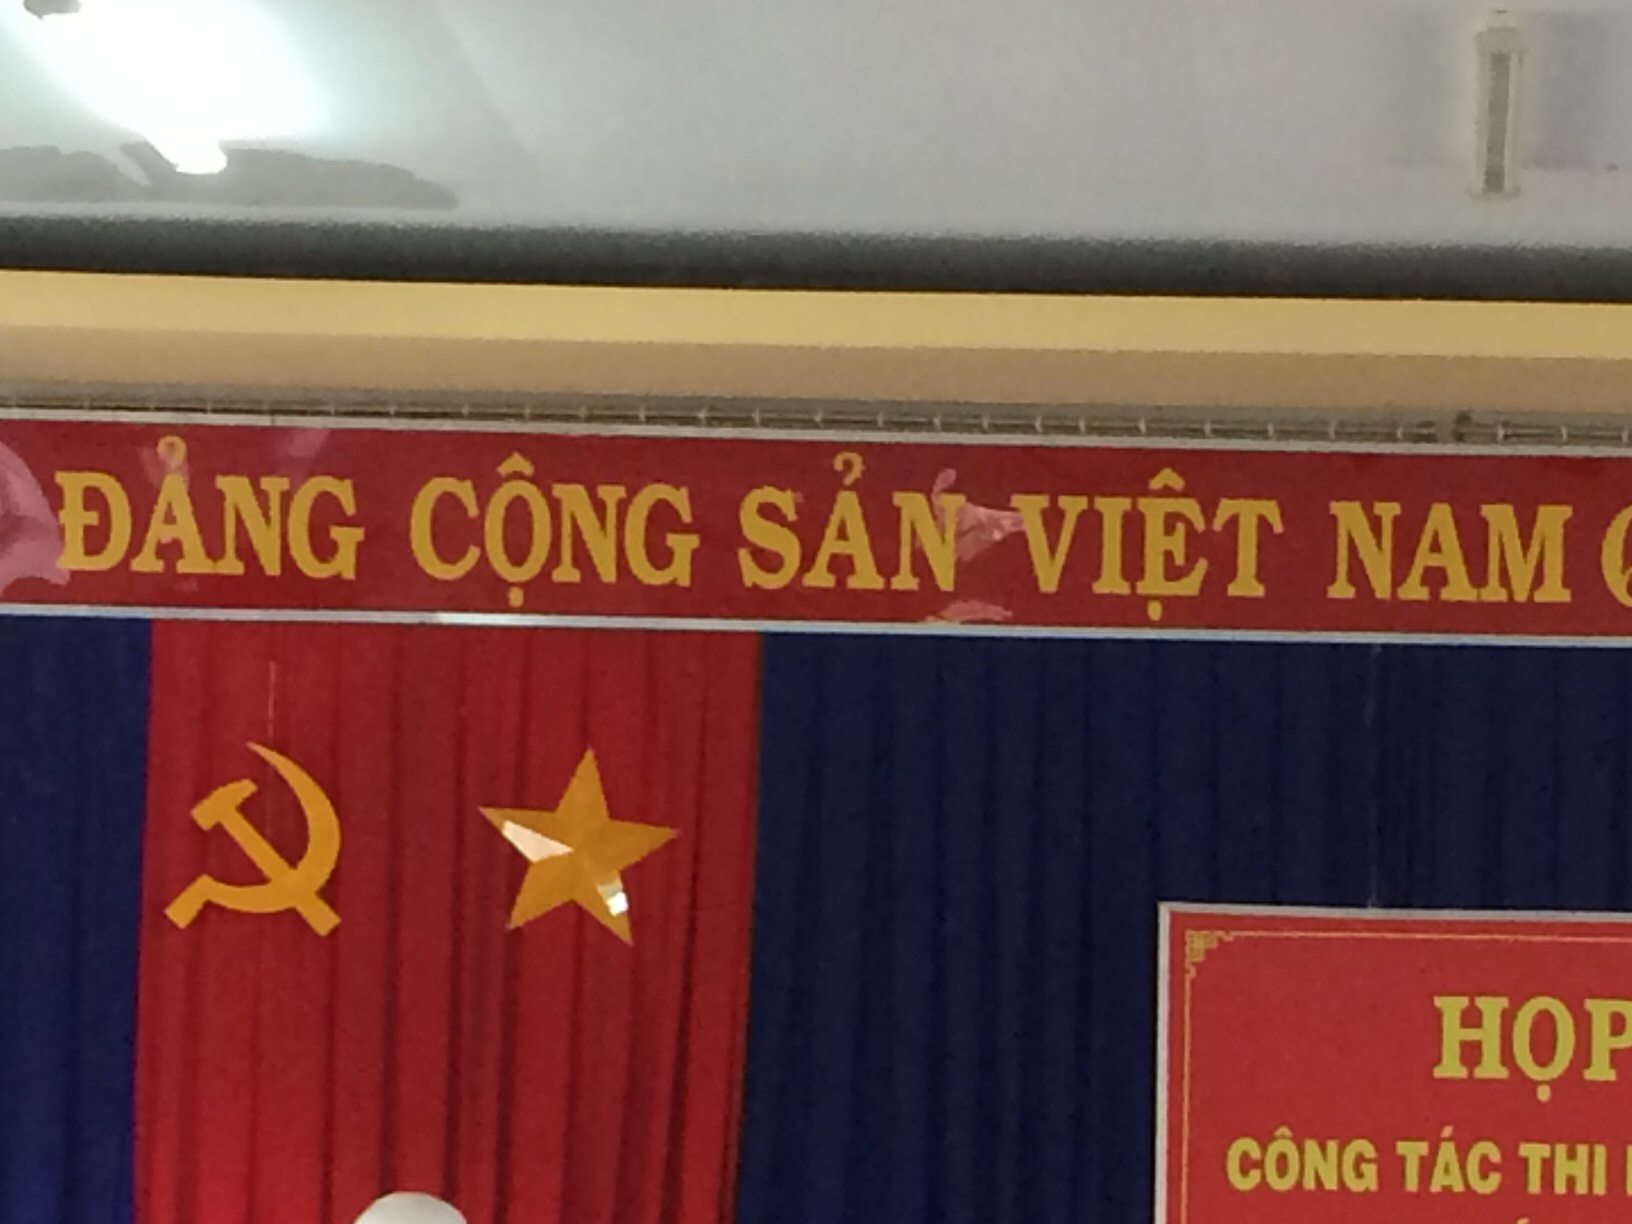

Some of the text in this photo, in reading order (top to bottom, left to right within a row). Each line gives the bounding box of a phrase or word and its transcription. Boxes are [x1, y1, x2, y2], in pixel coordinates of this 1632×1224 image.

[55, 435, 365, 579] ĐẢNG
[410, 454, 700, 608] CỘNG
[738, 452, 966, 590] SẢN
[1012, 468, 1283, 620] VIỆT
[1327, 501, 1573, 603] NAM
[1225, 1125, 1378, 1193] CÔNG
[1395, 1126, 1502, 1195] TÁC
[1517, 1141, 1608, 1196] THI
